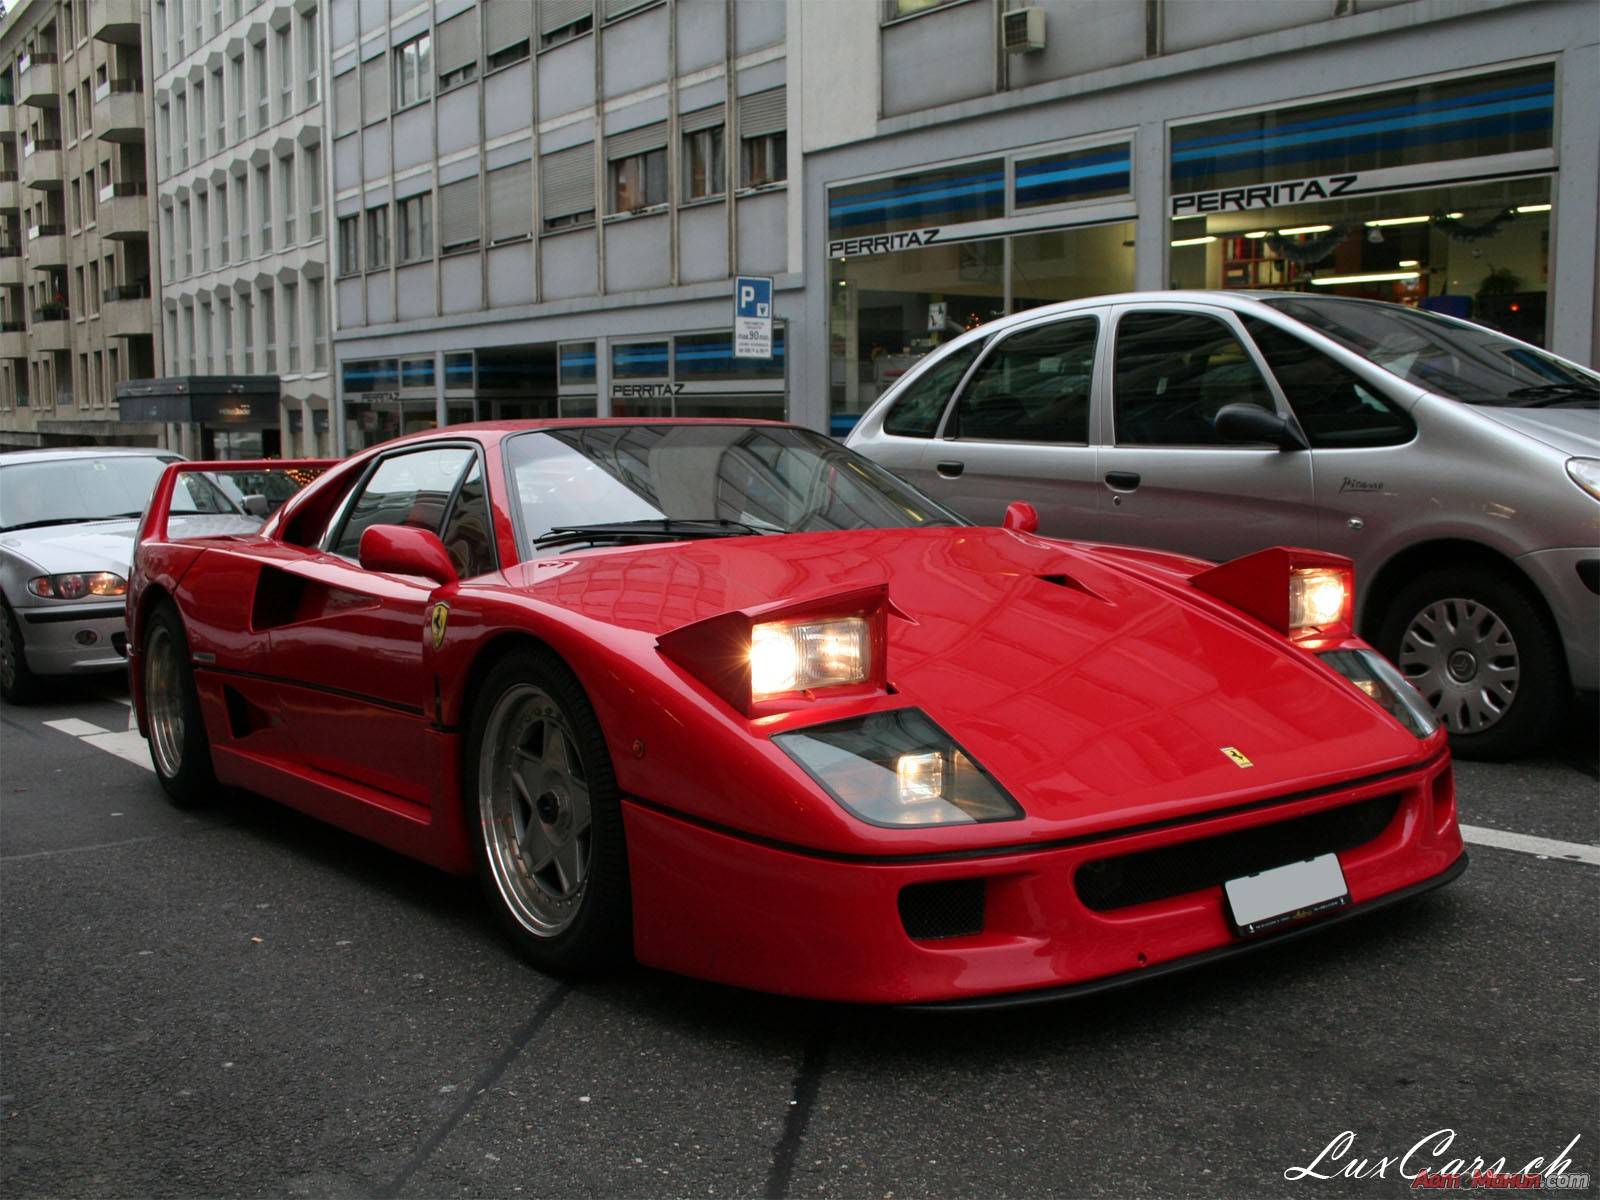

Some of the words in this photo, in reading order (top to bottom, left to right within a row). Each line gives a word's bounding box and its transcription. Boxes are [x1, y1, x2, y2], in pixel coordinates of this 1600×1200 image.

[1172, 175, 1357, 215] PERRITAZ
[829, 228, 939, 256] PERRITAZ
[741, 286, 755, 309] P
[749, 330, 759, 341] 90
[612, 383, 684, 399] PERRITAZ
